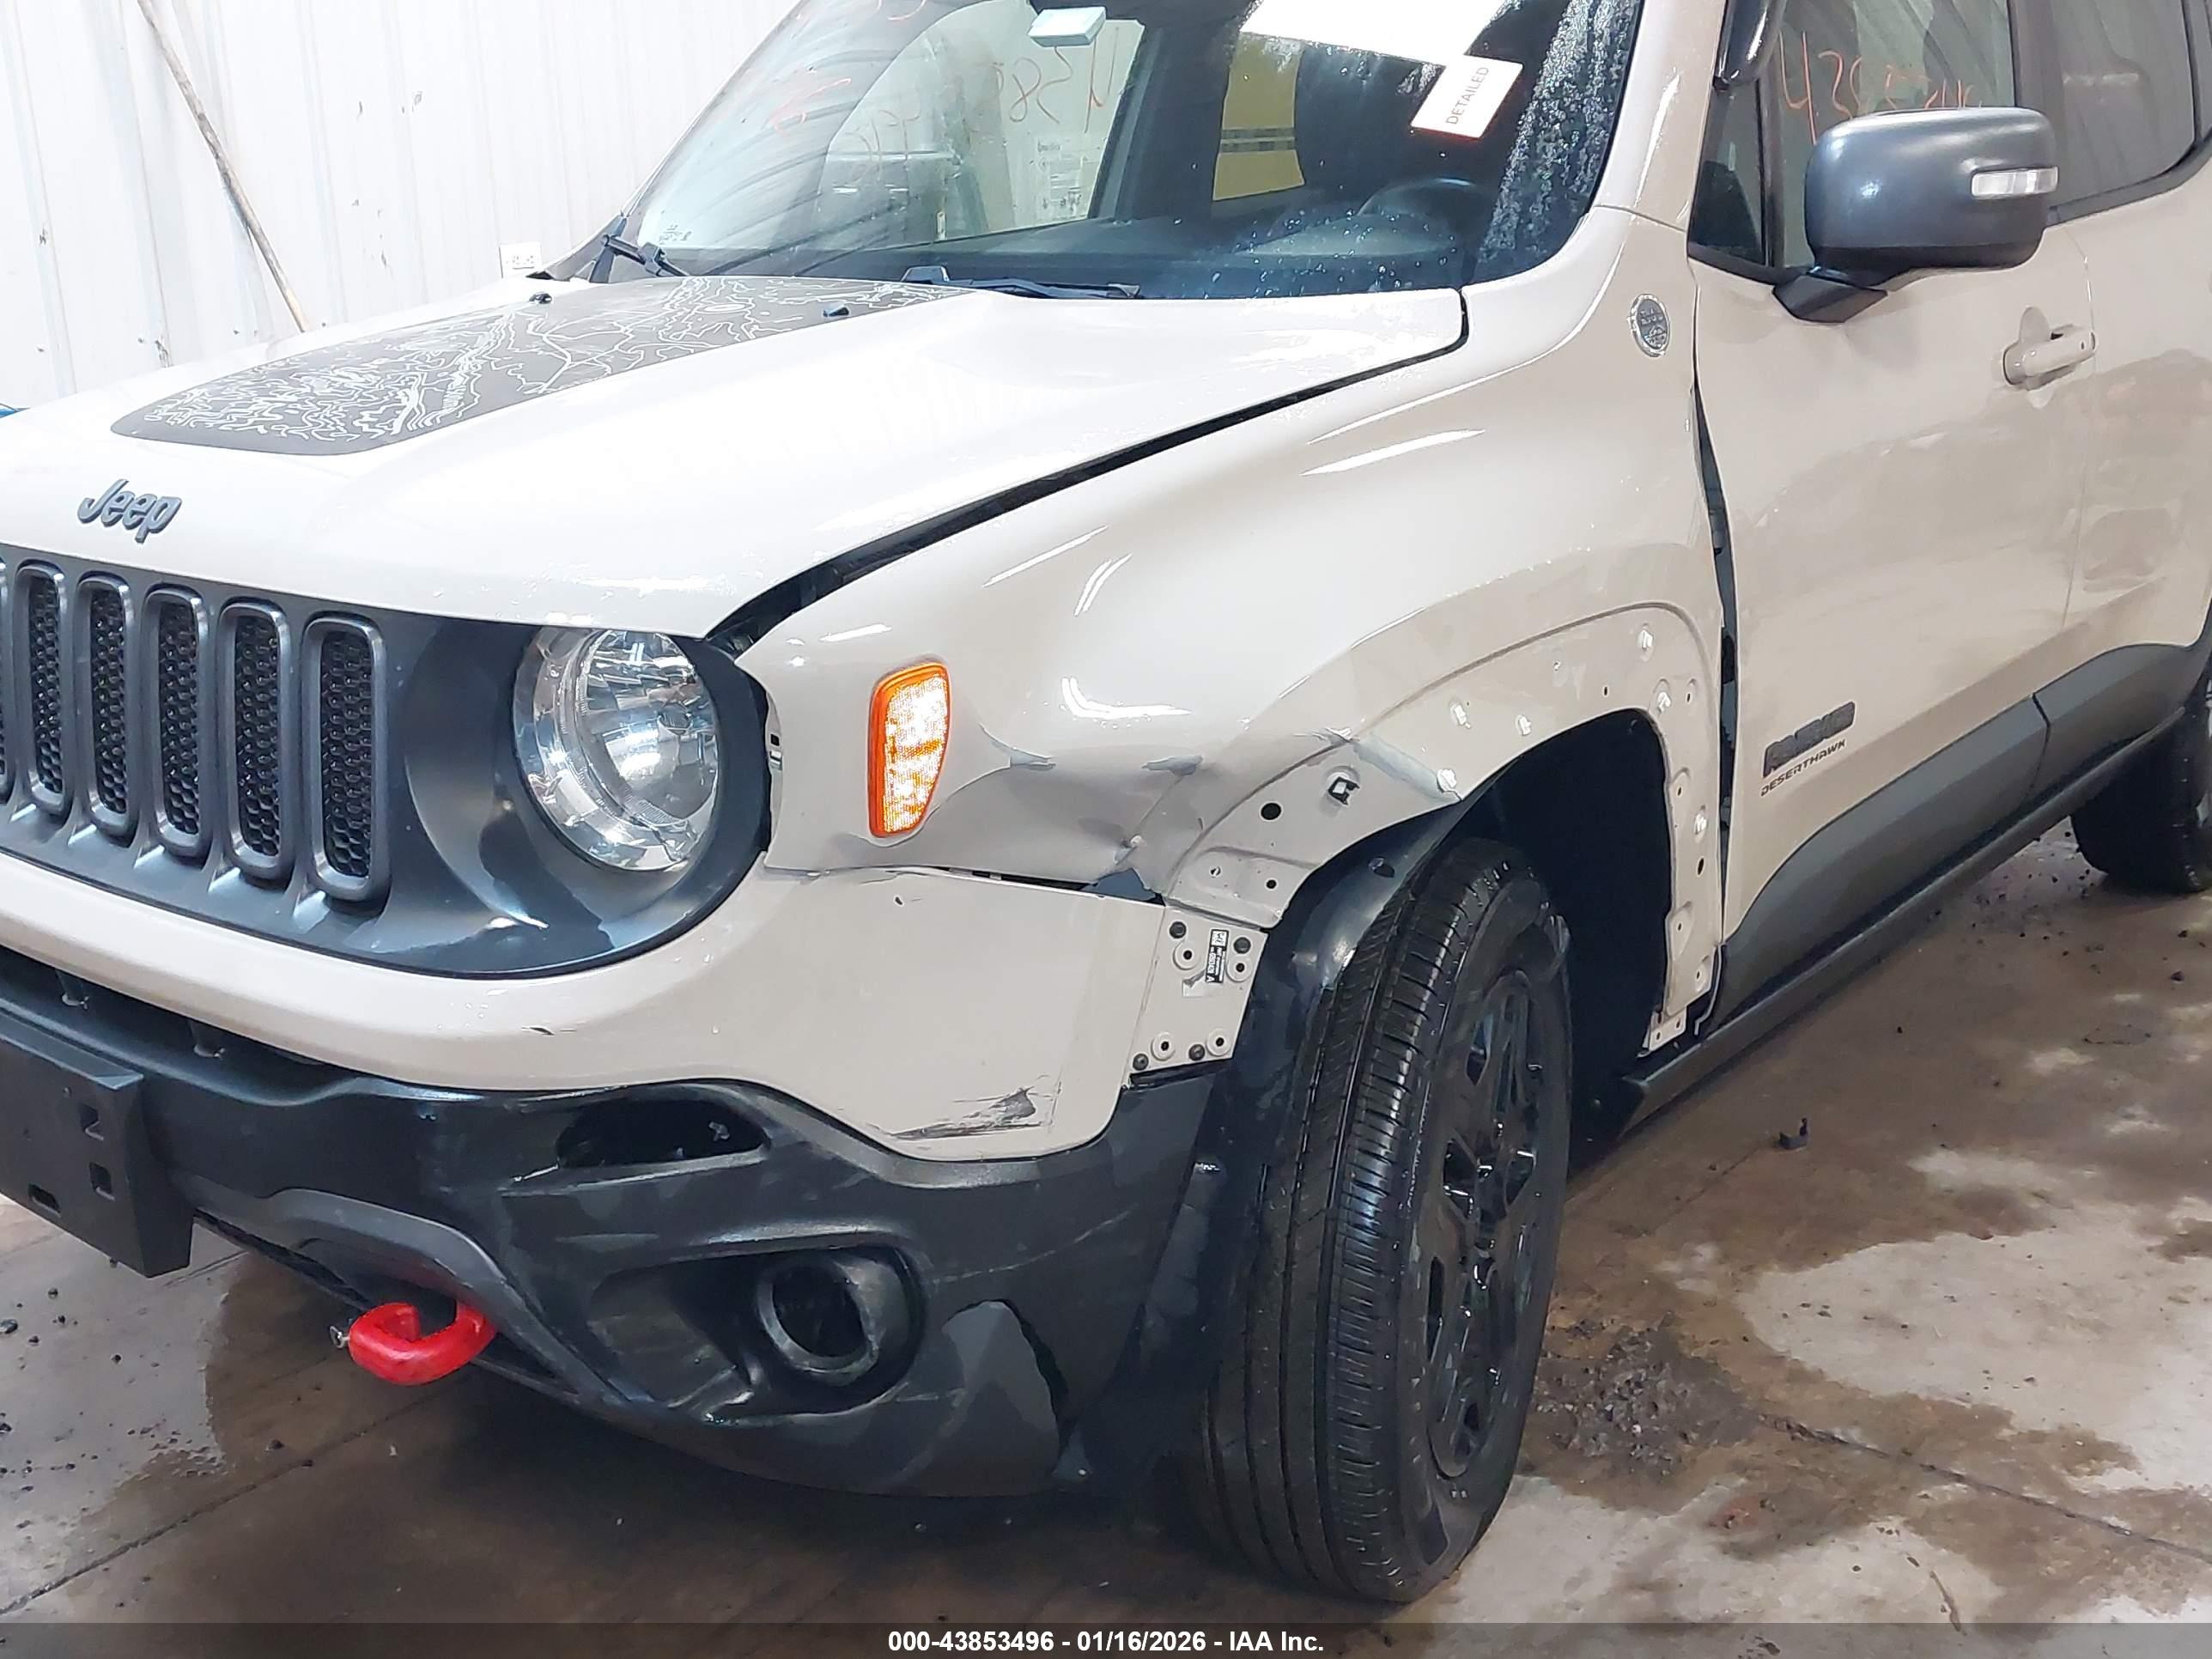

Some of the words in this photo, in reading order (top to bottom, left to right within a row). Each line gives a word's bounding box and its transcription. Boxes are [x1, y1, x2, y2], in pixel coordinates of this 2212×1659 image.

[1445, 67, 1489, 125] DETAILED
[77, 478, 182, 544] Jeep
[1761, 738, 1845, 797] DESERTHAWK
